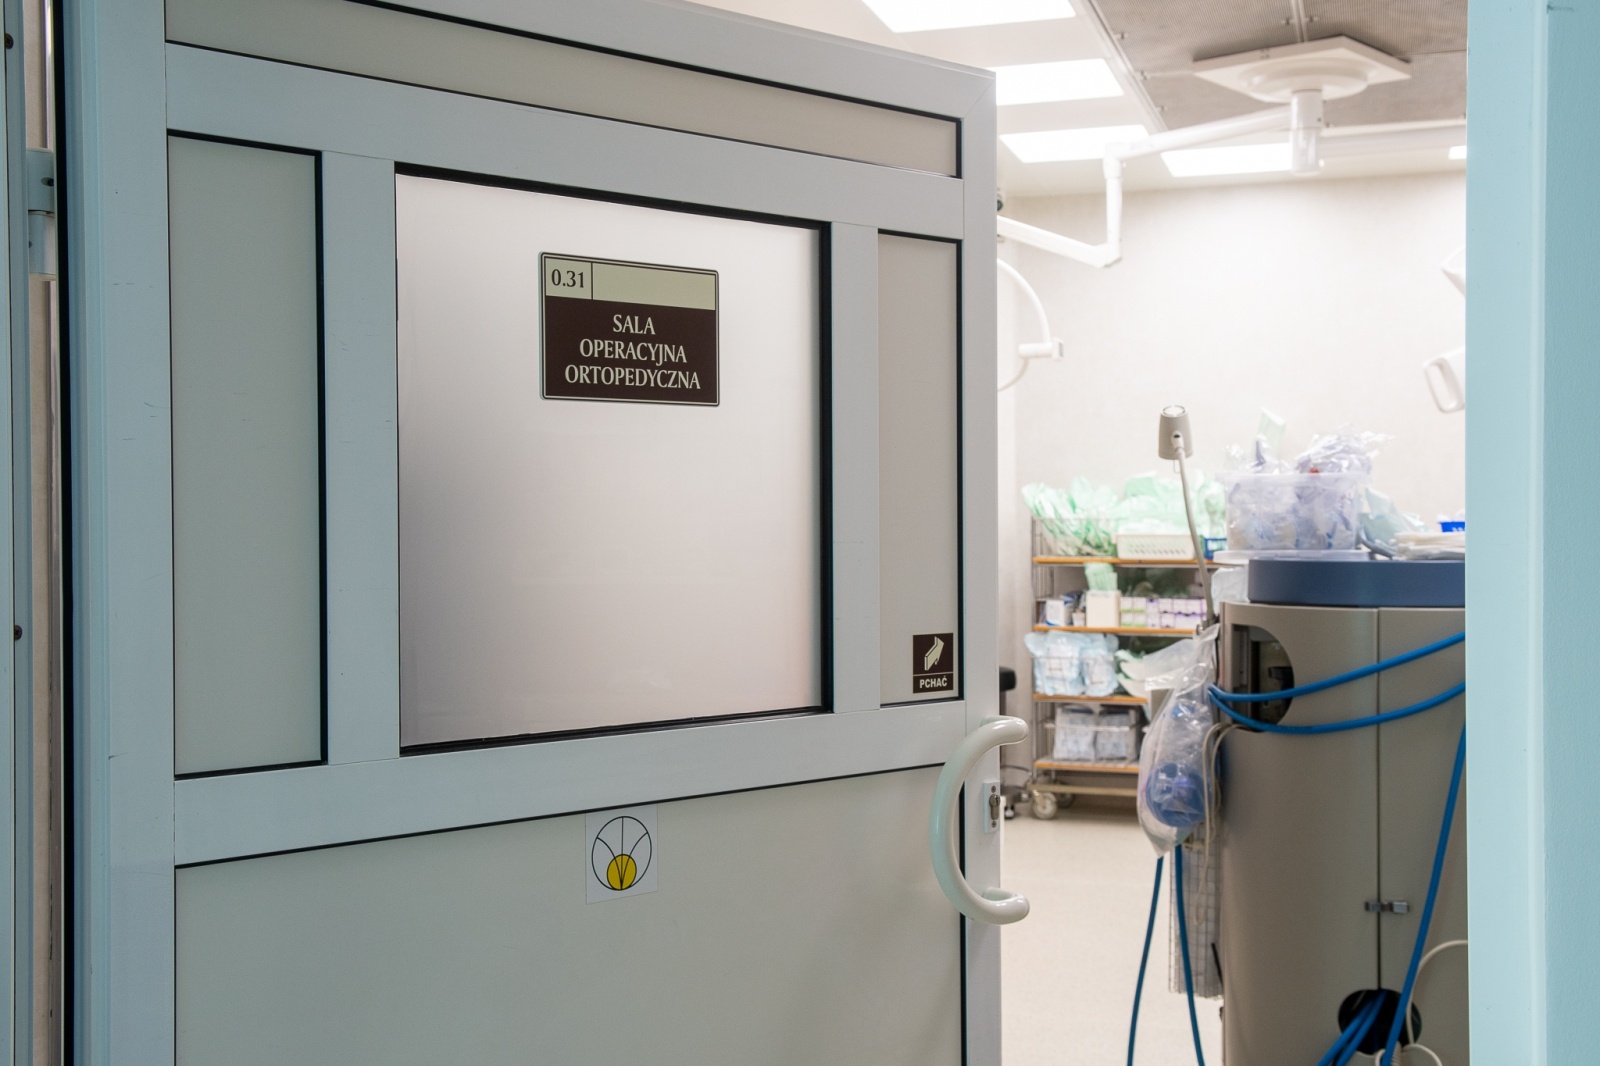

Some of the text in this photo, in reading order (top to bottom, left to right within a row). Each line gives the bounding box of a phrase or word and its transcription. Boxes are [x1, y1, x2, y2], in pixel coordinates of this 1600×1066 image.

[551, 268, 584, 288] 0.31
[612, 314, 656, 335] SALA
[579, 338, 687, 366] OPERACYJNA
[564, 364, 701, 389] ORTOPEDYCZNA
[919, 675, 948, 689] PCHAĆ
